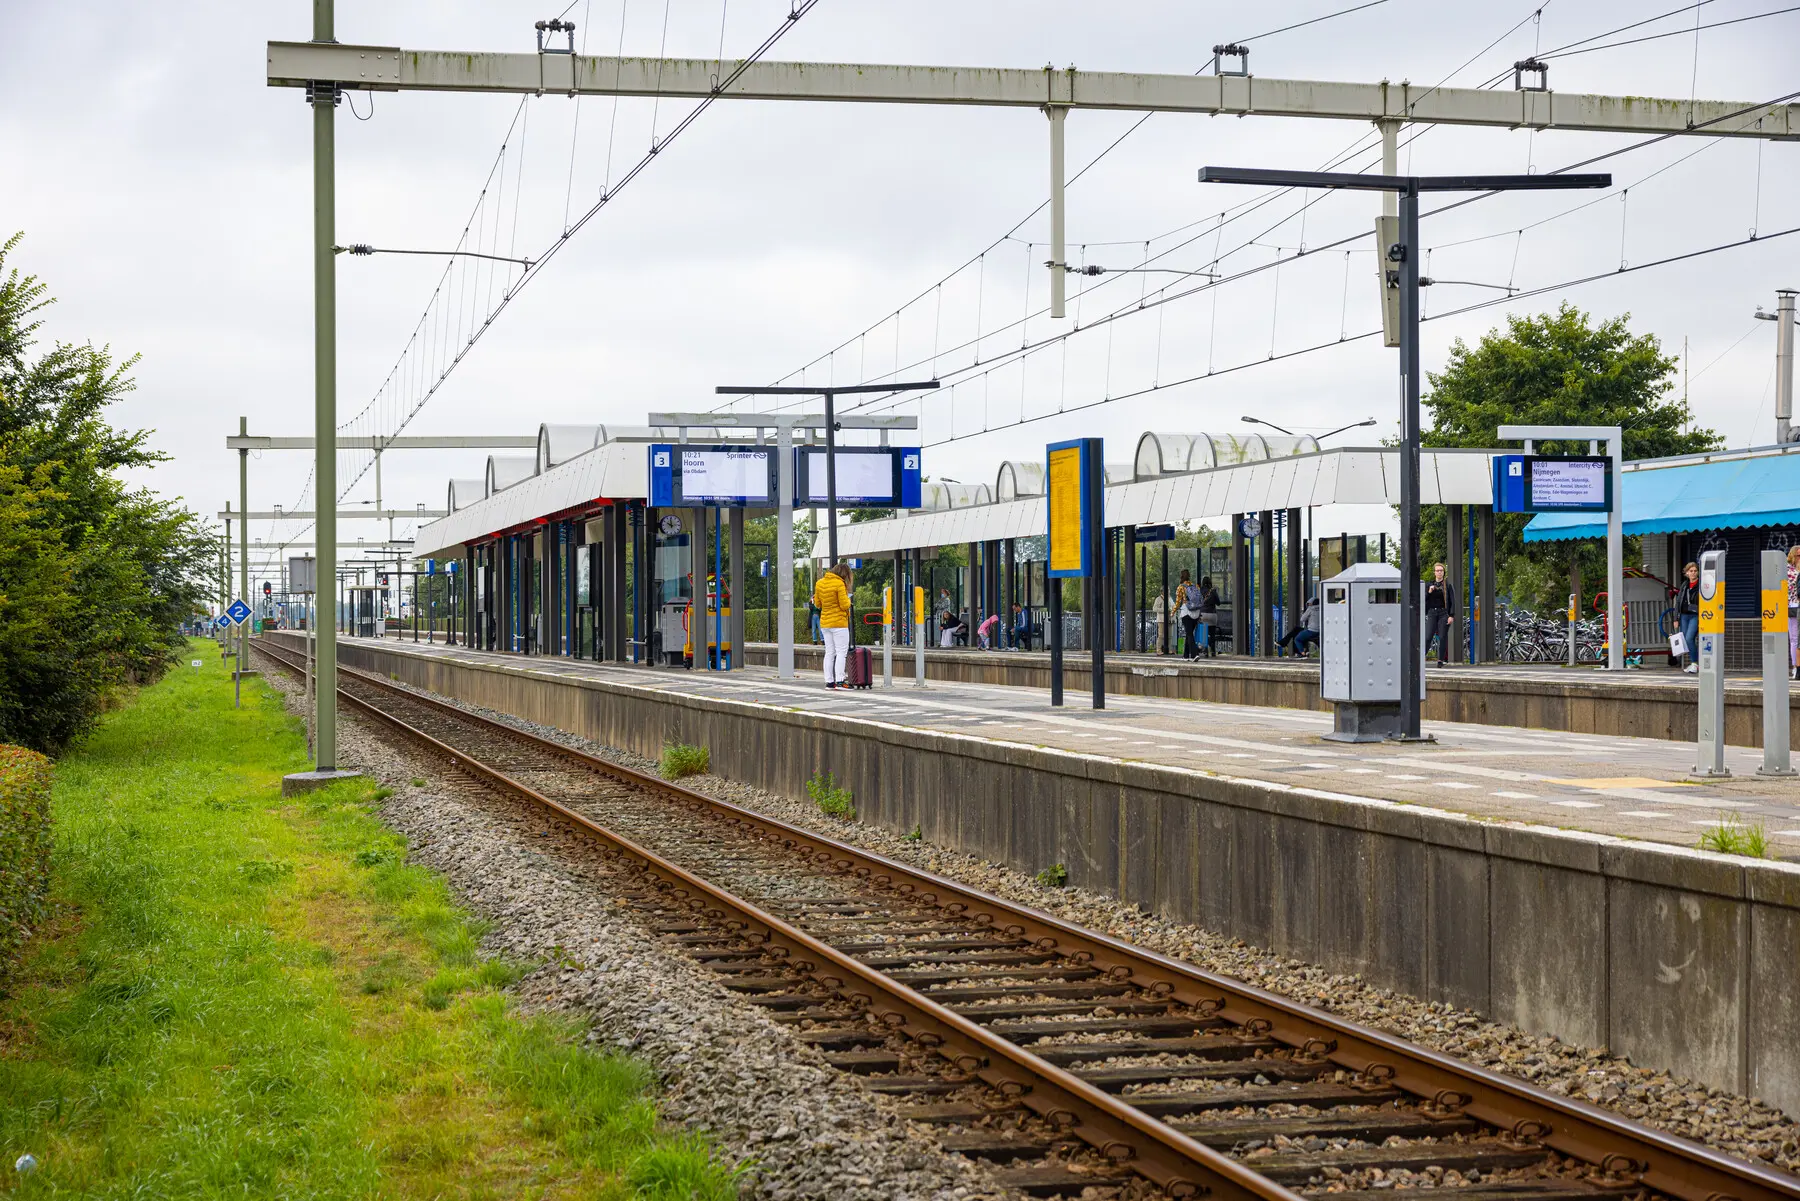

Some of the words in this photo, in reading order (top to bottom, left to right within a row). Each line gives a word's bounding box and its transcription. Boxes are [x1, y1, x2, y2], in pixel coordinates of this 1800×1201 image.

[726, 452, 752, 460] Sprinter
[659, 457, 665, 466] 3
[908, 460, 914, 468] 2
[234, 606, 244, 617] 2
